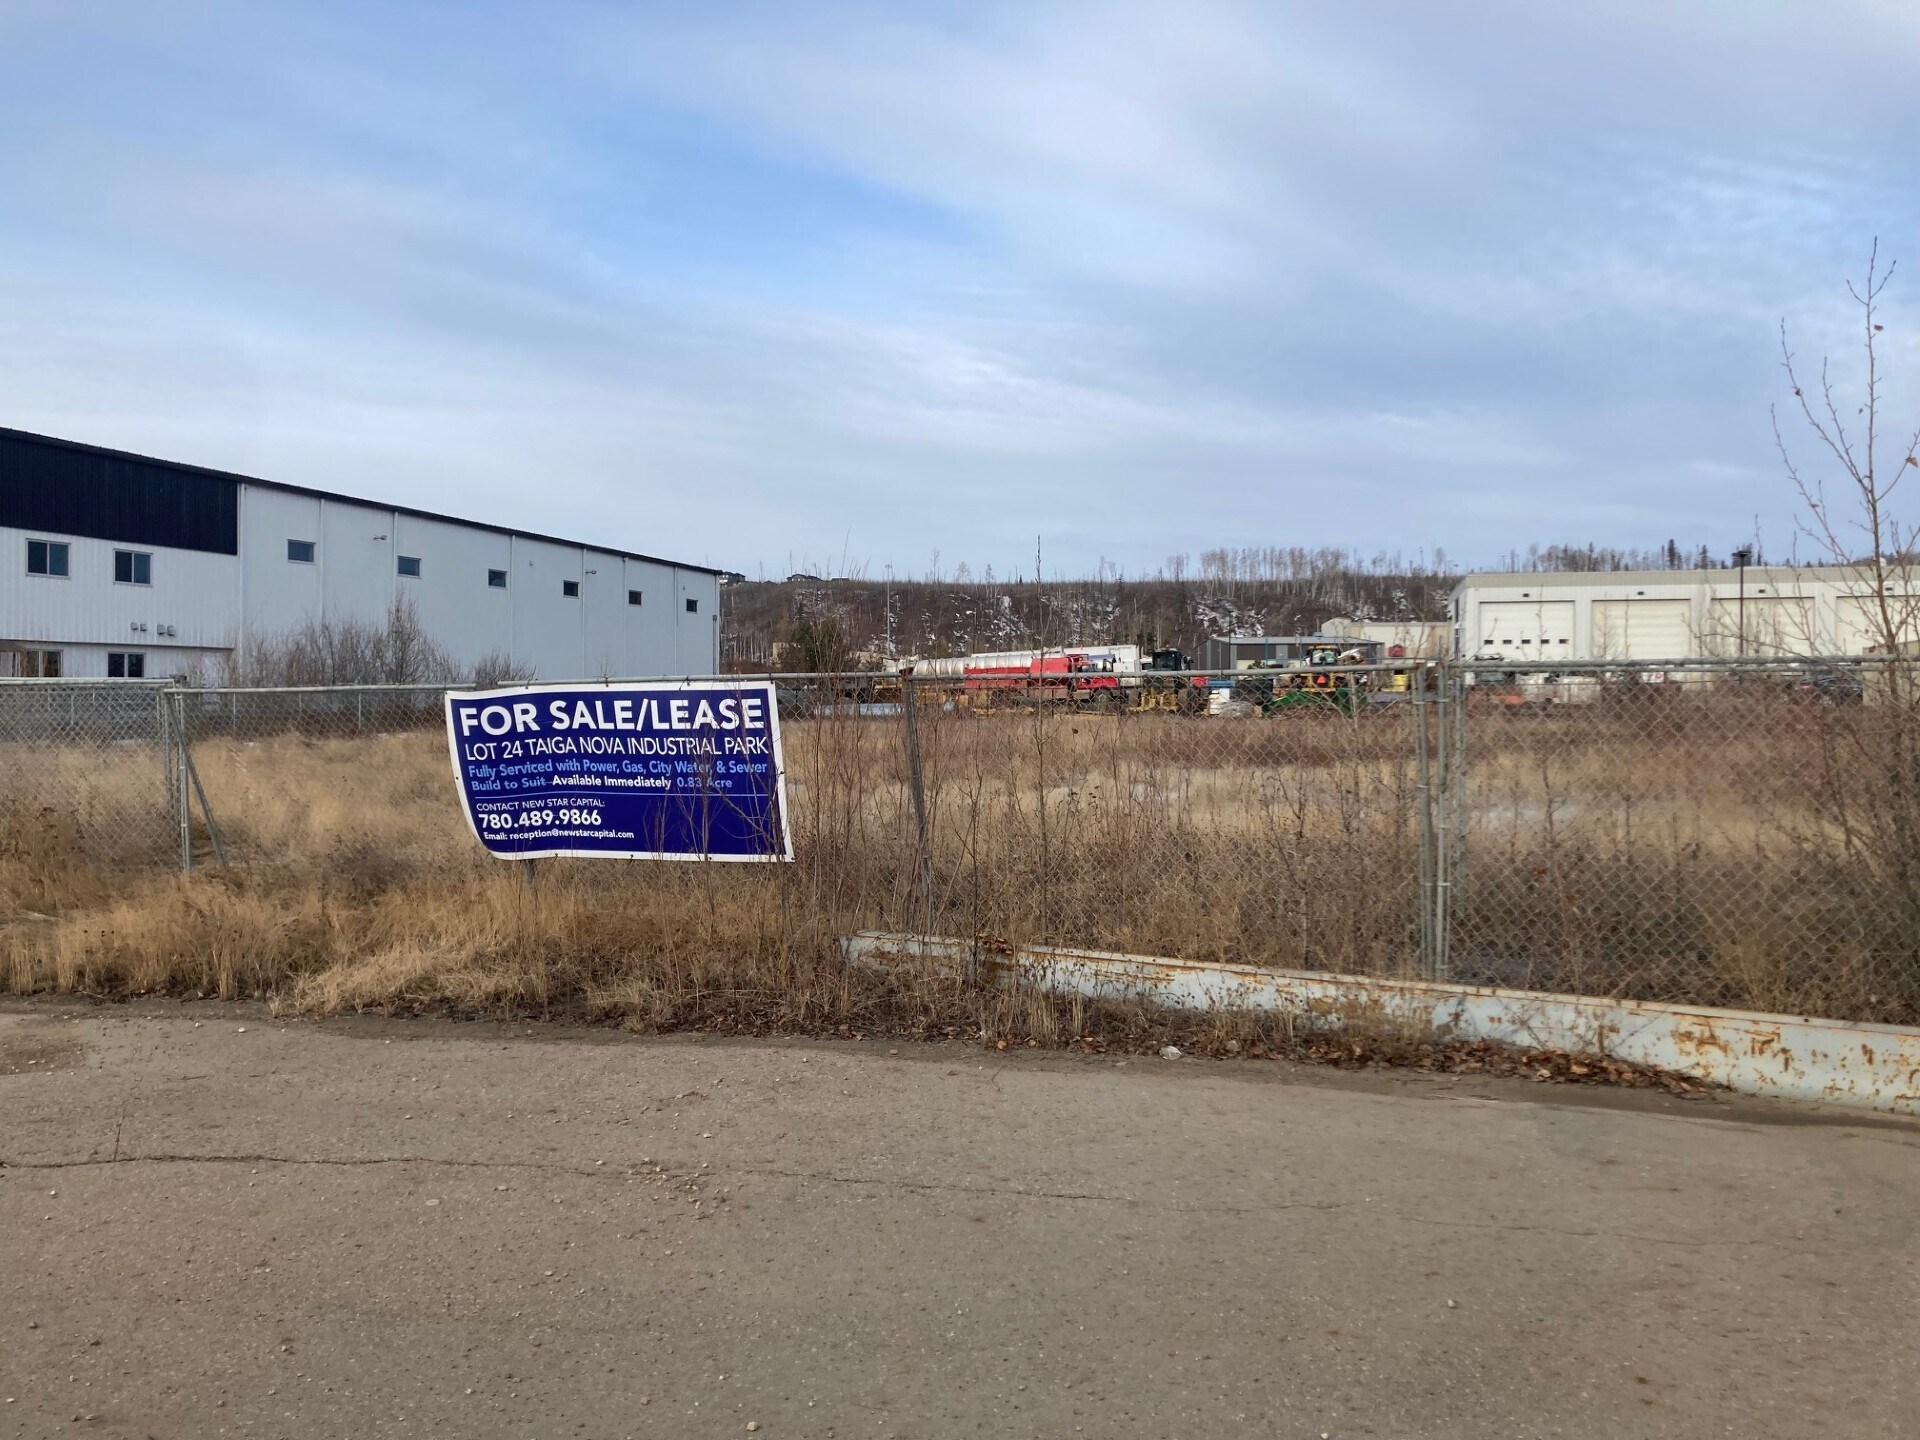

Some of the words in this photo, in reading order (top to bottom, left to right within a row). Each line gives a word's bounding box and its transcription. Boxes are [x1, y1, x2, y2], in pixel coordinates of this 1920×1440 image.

[459, 703, 541, 737] FOR
[550, 698, 765, 732] SALE/LEASE
[465, 743, 497, 761] LOT
[501, 740, 523, 759] 24
[525, 736, 578, 756] TAIGA
[579, 736, 626, 754] NOVA
[627, 737, 722, 755] INDUSTRIAL
[724, 736, 769, 755] PARK
[468, 765, 496, 780] Fully
[500, 759, 553, 777] Serviced
[556, 758, 580, 772] with
[583, 759, 620, 774] Power,
[622, 760, 647, 774] Gas,
[649, 761, 672, 777] City
[716, 761, 726, 773] &
[729, 760, 768, 774] Sewer
[471, 780, 500, 791] Build
[504, 779, 518, 789] to
[521, 776, 546, 788] Suit
[552, 775, 602, 786] Available
[604, 776, 671, 790] Immediately
[476, 802, 519, 811] CONTACT
[522, 800, 544, 809] NEW
[546, 798, 569, 807] STAR
[570, 798, 606, 807] CAPITAL:
[478, 809, 602, 829] 780.489.9866
[483, 832, 508, 840] Email:
[509, 828, 635, 840] reception@newstarcapital.com
